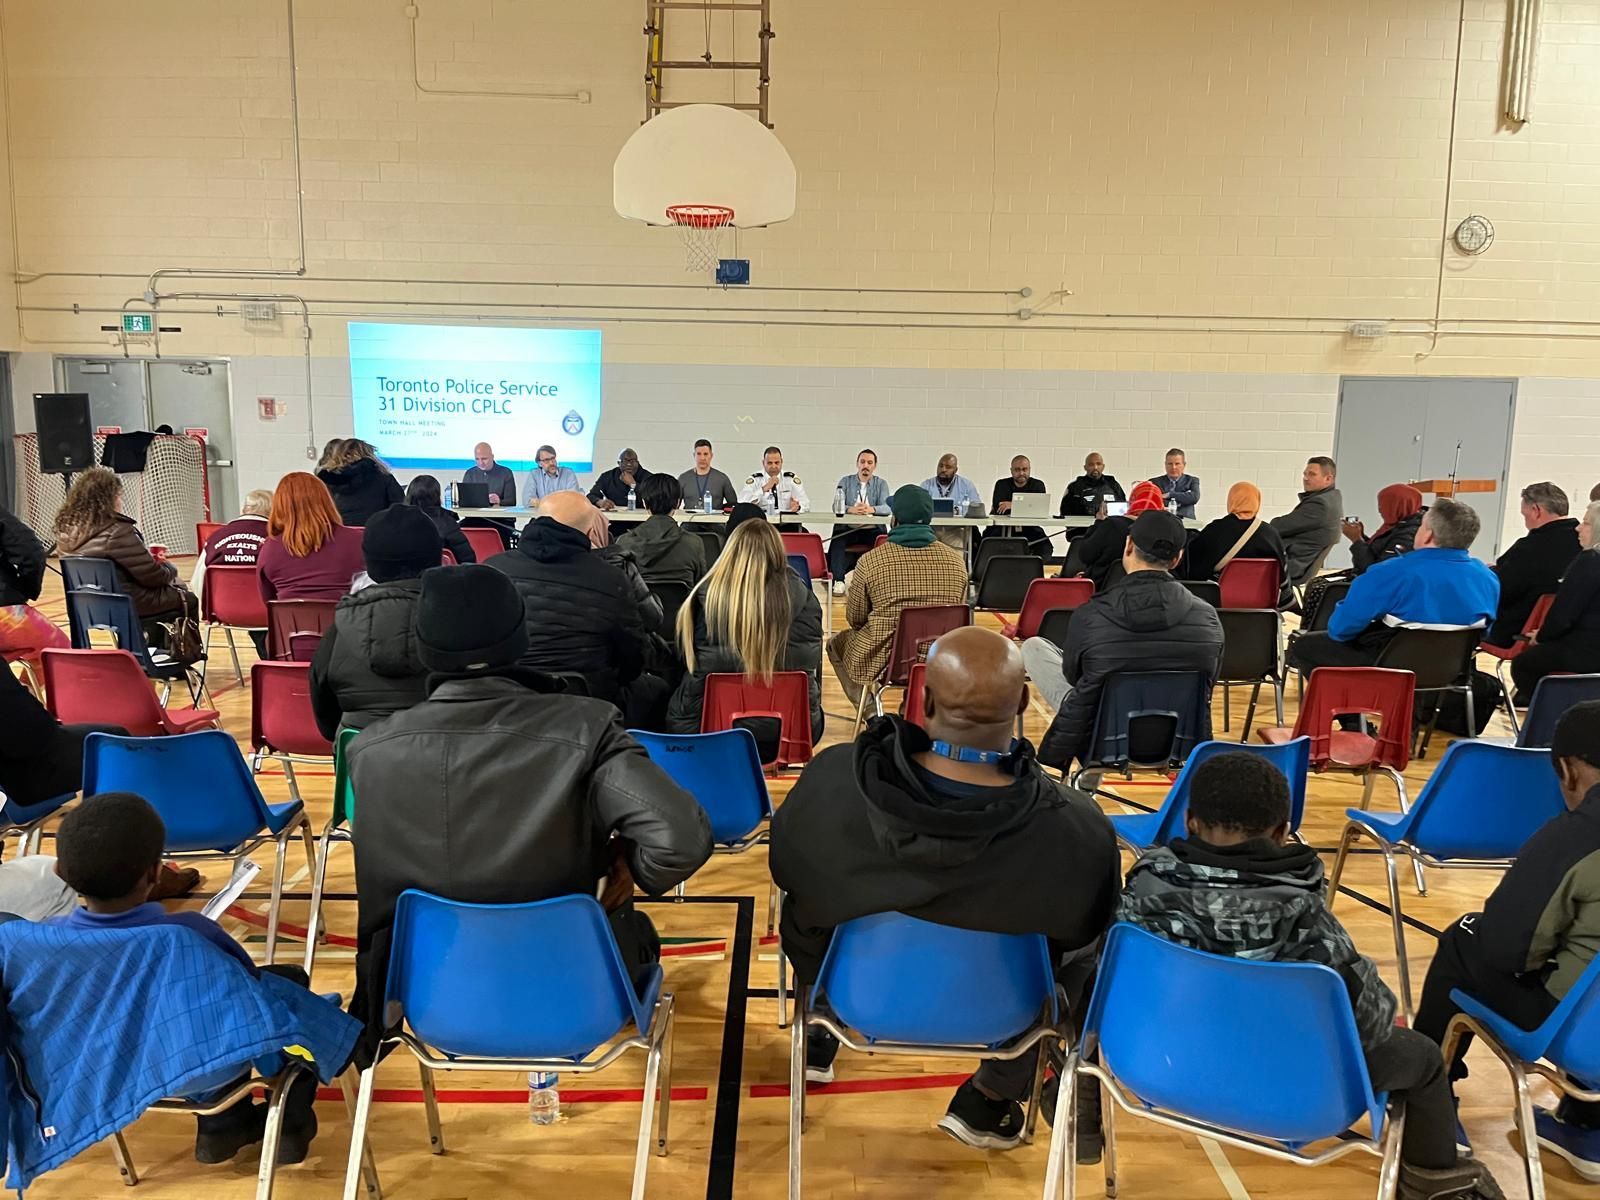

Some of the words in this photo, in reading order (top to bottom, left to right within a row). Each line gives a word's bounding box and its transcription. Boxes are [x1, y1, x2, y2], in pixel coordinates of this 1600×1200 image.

[376, 377, 439, 393] Toronto
[446, 379, 494, 394] Police
[499, 380, 558, 396] Service
[379, 396, 395, 411] 31
[403, 397, 465, 413] Division
[472, 399, 512, 414] CPLC
[226, 542, 257, 550] EXALTS
[224, 554, 256, 562] NATION
